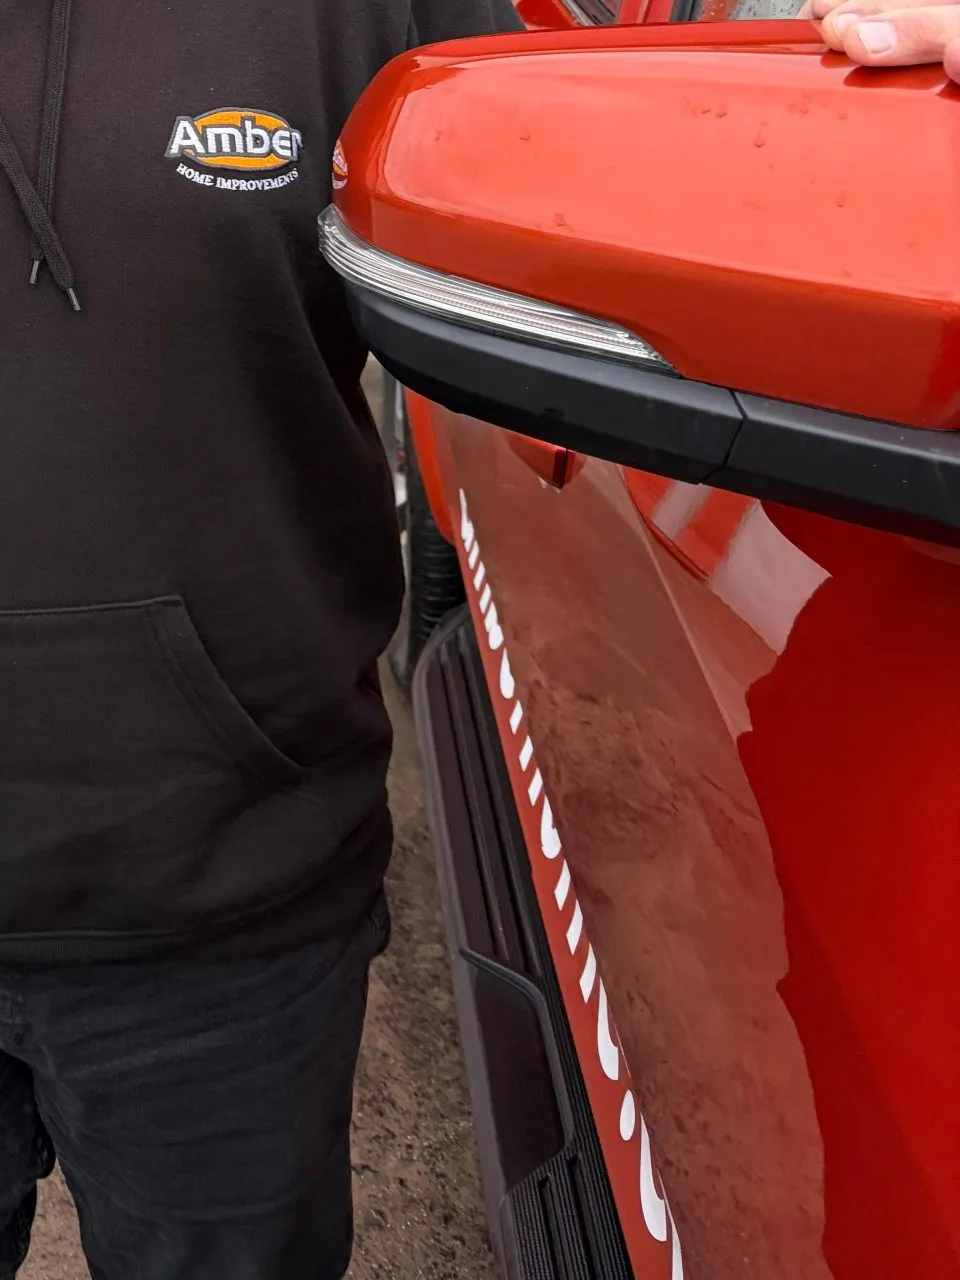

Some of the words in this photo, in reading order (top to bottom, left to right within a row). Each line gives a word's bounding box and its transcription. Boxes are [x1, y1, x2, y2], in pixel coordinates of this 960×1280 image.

[169, 119, 304, 158] Amber
[176, 162, 214, 186] HOME
[216, 167, 300, 191] IMPROVEMENTS
